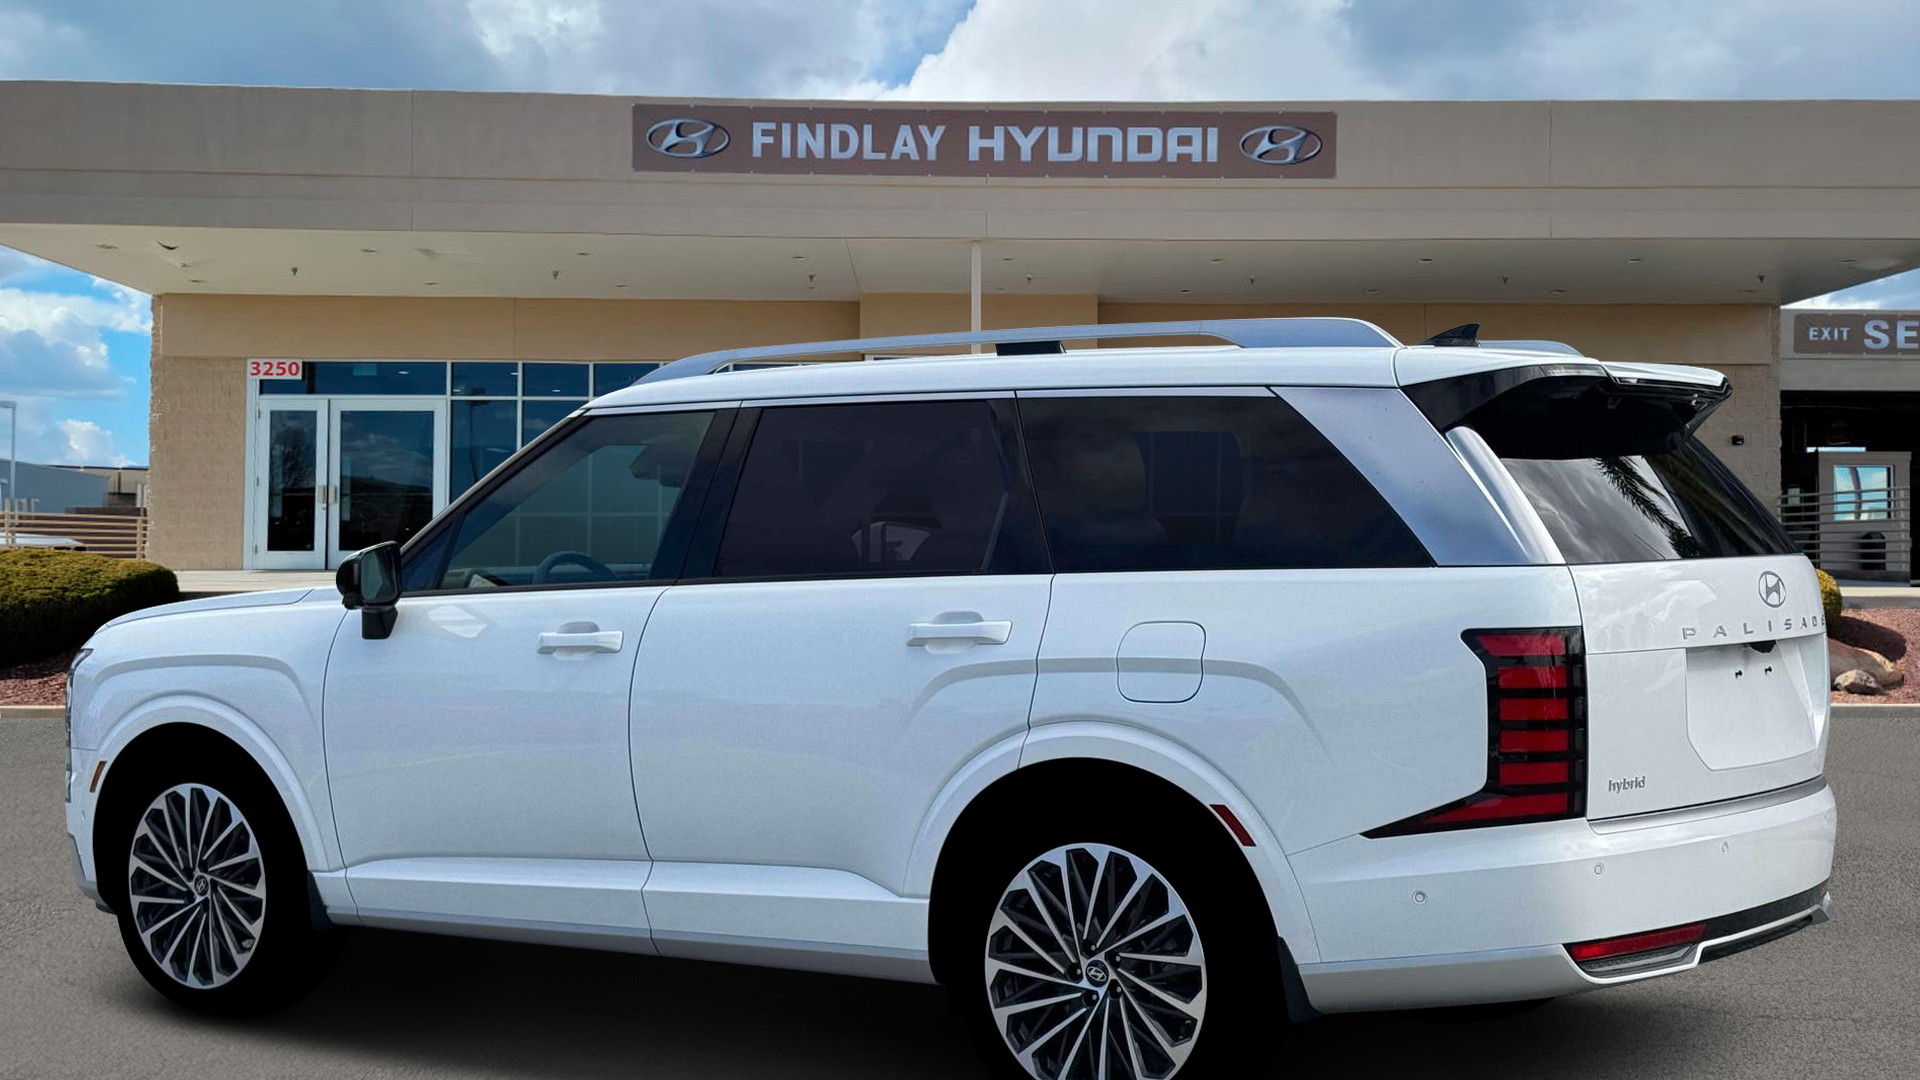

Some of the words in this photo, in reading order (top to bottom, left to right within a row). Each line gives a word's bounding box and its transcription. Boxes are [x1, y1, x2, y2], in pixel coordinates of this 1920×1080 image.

[752, 122, 946, 161] FINDLAY
[968, 126, 1218, 163] HYUNDAI
[1808, 326, 1850, 341] EXIT
[249, 361, 300, 376] 3250
[1608, 776, 1646, 794] hybrid
